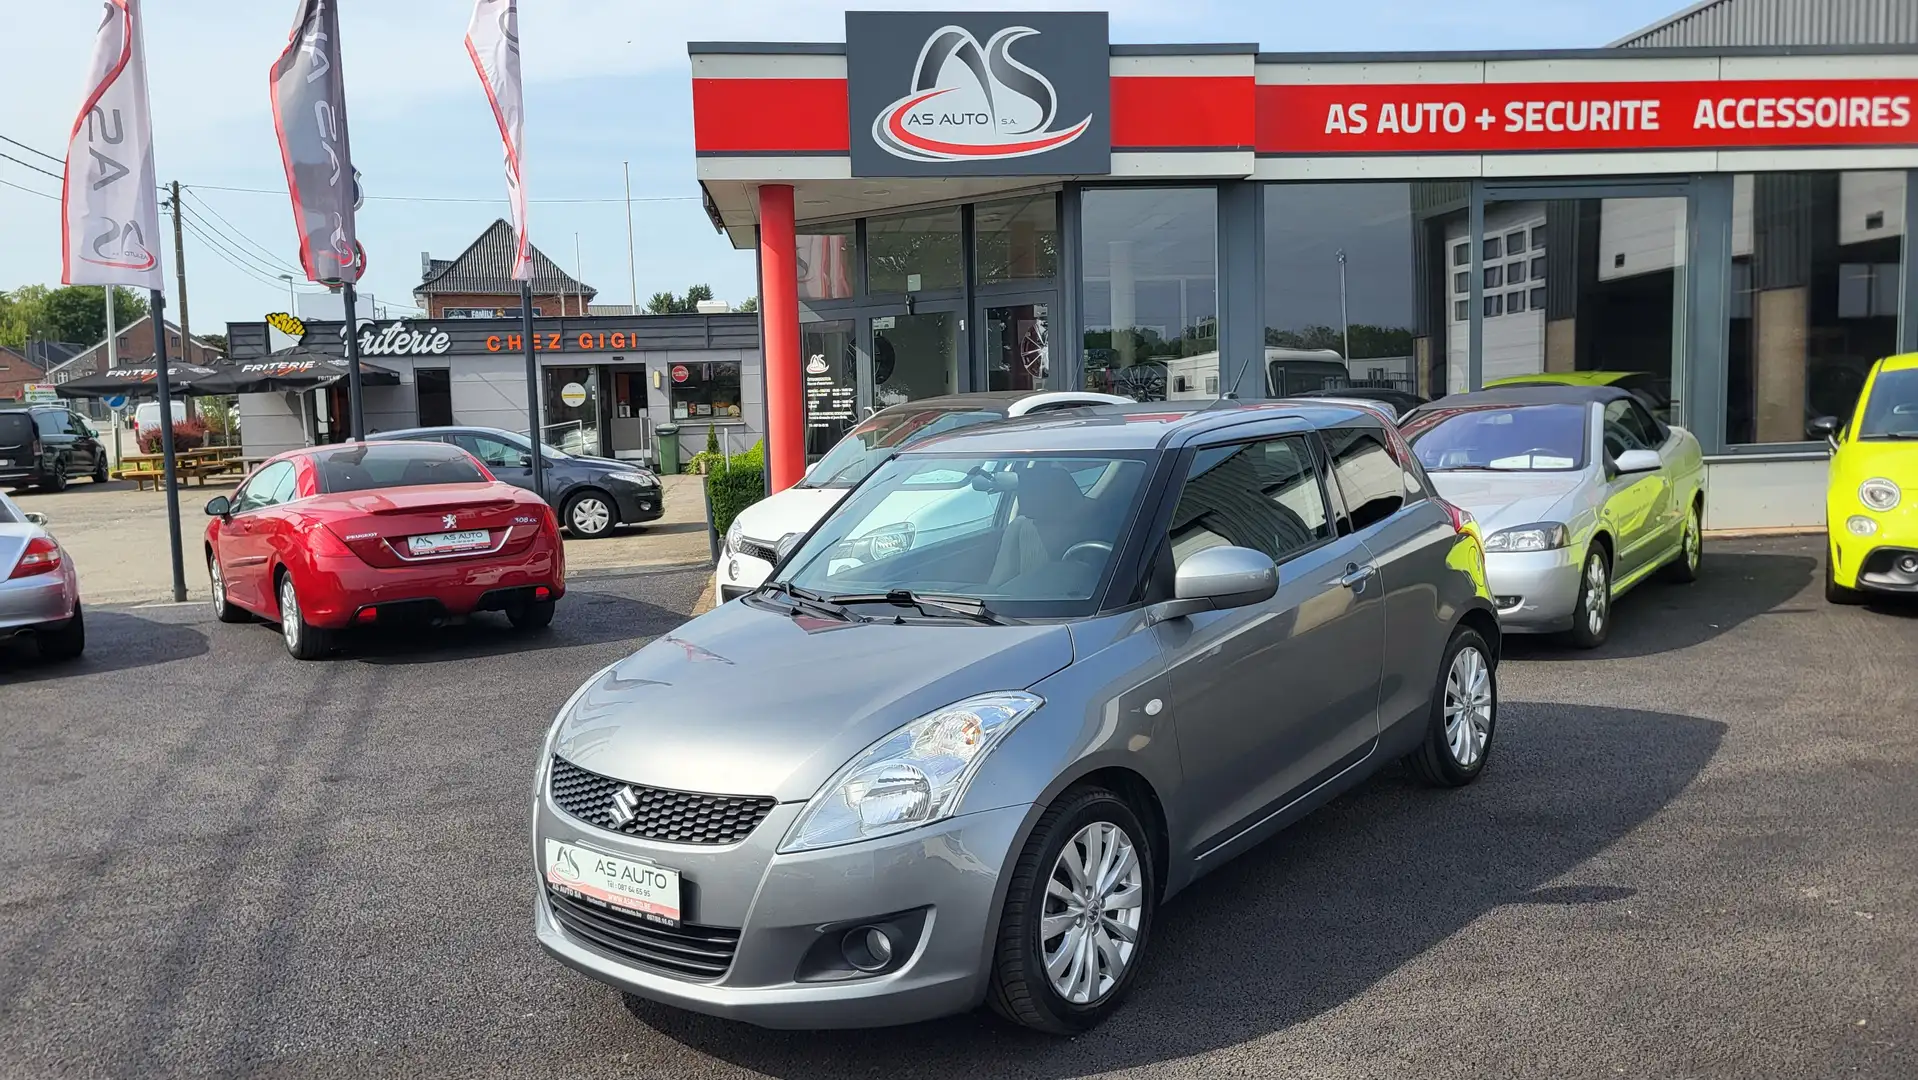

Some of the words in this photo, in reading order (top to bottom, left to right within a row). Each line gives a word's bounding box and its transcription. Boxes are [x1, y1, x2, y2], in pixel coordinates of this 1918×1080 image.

[907, 113, 934, 126] AS
[939, 113, 989, 126] AUTO
[1324, 103, 1368, 135] AS
[1377, 102, 1466, 134] AUTO
[1505, 99, 1661, 133] SECURITE
[1693, 96, 1911, 130] ACCESSOIRES
[471, 310, 494, 319] FAMILY
[487, 333, 561, 352] CHEZ
[578, 332, 637, 349] GIGI
[241, 365, 316, 378] FRITERIE
[346, 532, 378, 541] PEUGEOT
[443, 533, 456, 541] AS
[459, 531, 483, 540] AUTO
[594, 859, 617, 878] AS
[621, 866, 667, 889] AUTO
[552, 883, 559, 891] AS
[560, 885, 574, 896] AUTO
[617, 883, 627, 892] 087
